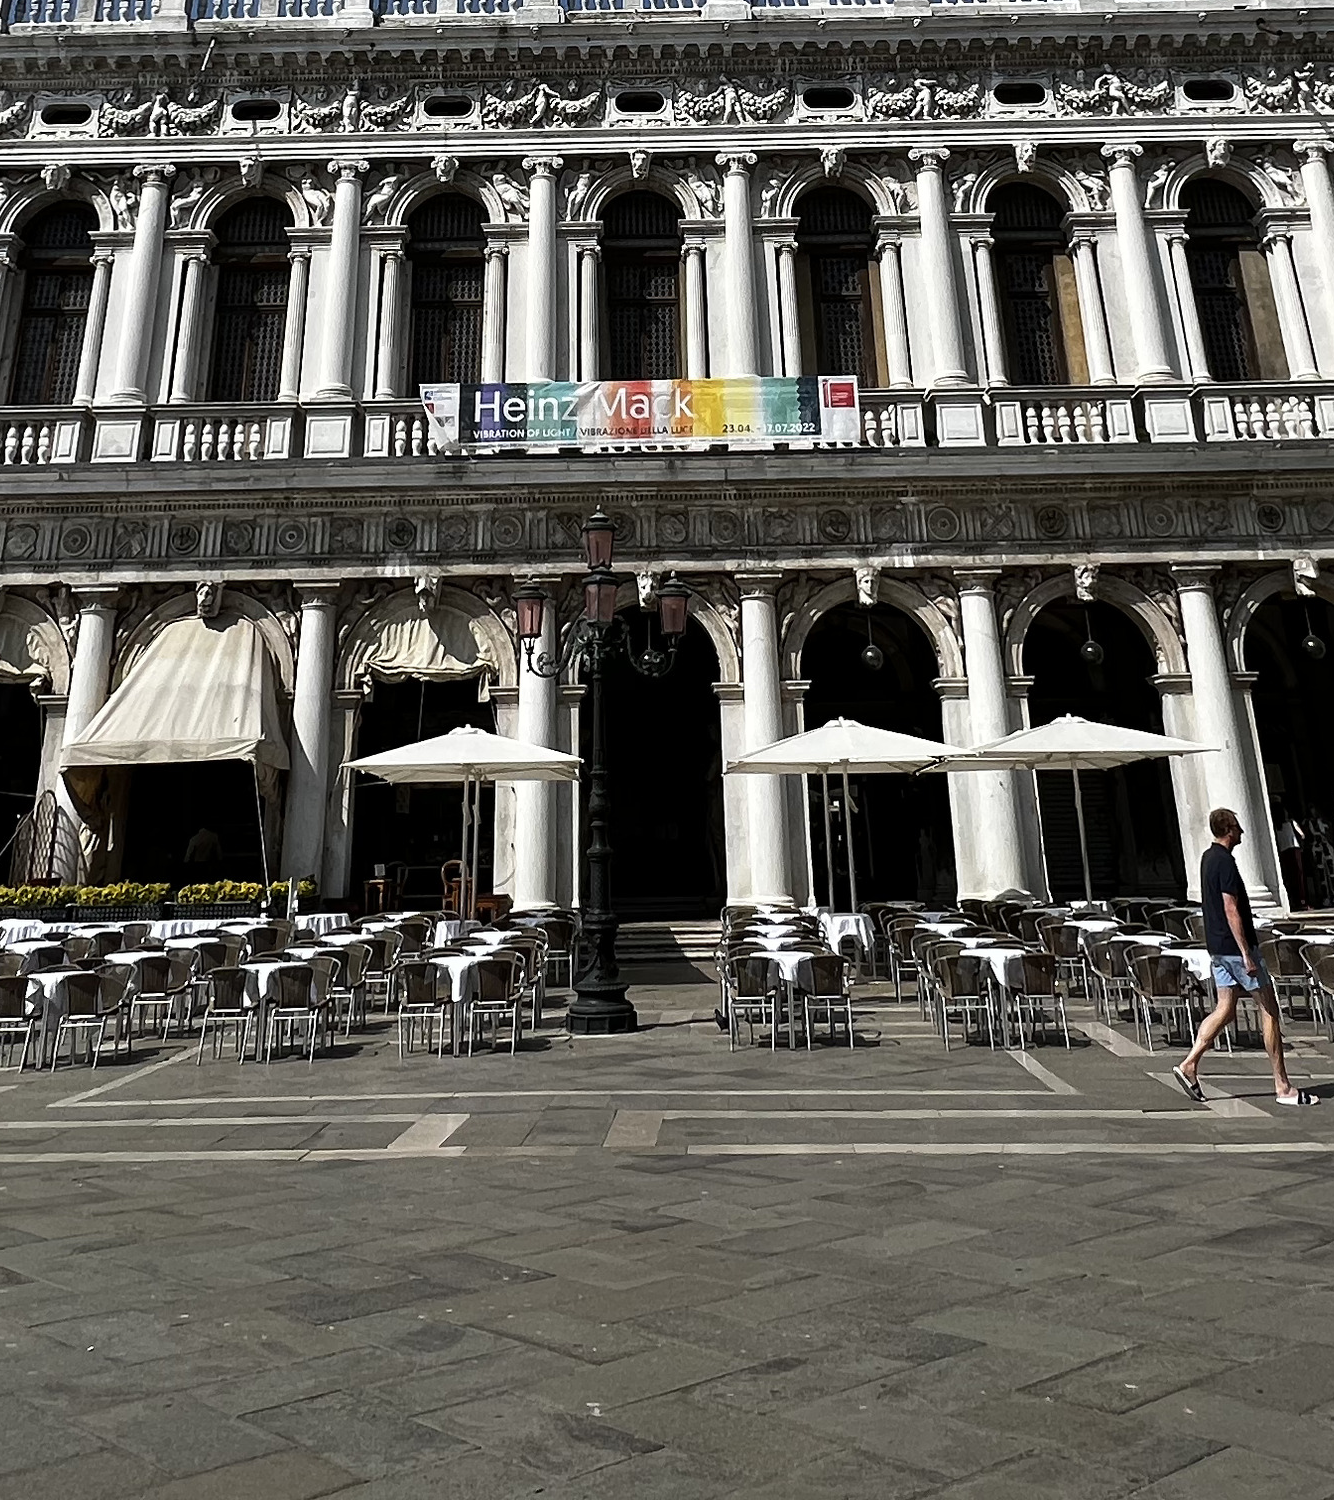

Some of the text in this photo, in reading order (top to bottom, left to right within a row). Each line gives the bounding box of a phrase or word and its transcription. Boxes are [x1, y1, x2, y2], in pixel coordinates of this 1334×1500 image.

[474, 387, 695, 422] Heinz Mack
[473, 429, 525, 439] VIBRATION
[527, 428, 540, 438] OF
[542, 428, 571, 438] LIGHT
[580, 425, 638, 436] VIBRAZIONE
[763, 422, 816, 433] 17.07.2022
